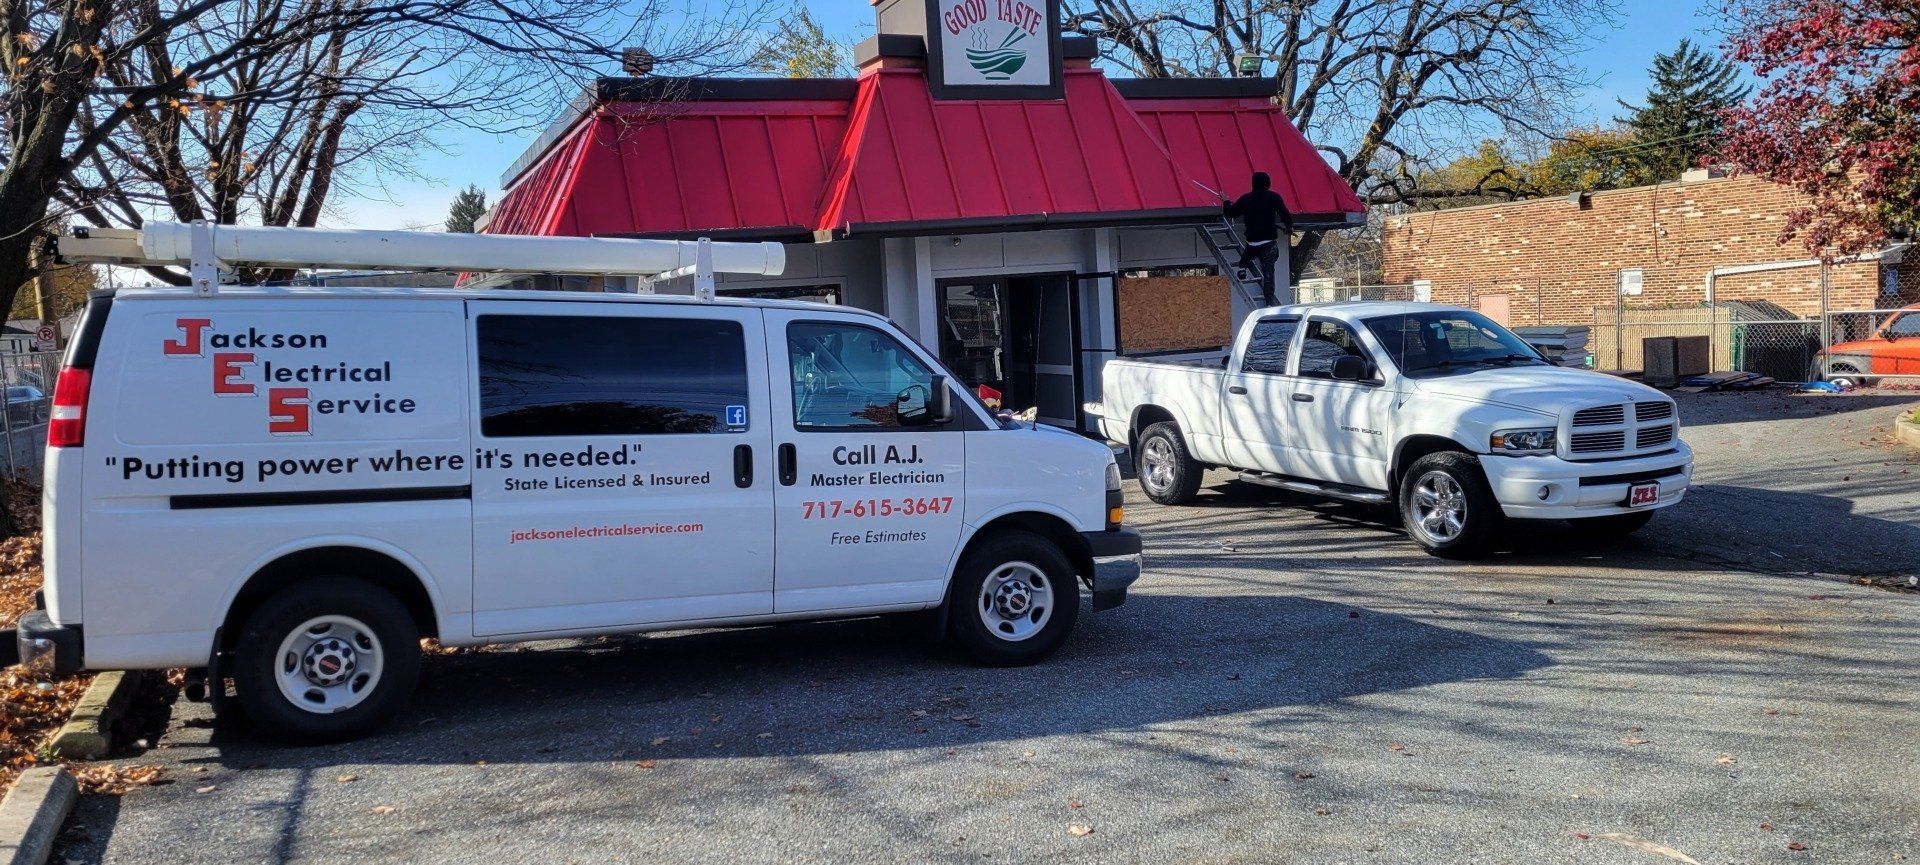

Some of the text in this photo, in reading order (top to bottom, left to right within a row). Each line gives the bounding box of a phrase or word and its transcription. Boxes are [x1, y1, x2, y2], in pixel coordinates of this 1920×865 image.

[944, 0, 1042, 37] GOOD TASTE
[163, 318, 328, 357] Jackson
[213, 353, 391, 397] Electrical
[269, 387, 416, 436] Service
[105, 444, 642, 483] "Putting power where it's needed."
[832, 444, 924, 465] Call A.J.
[504, 471, 711, 491] State Licensed & Insured
[811, 470, 944, 487] Master Electrician
[802, 496, 953, 520] 717-615-3647
[510, 522, 704, 544] jacksonelectricalservice.com
[831, 530, 927, 545] Free Estimates
